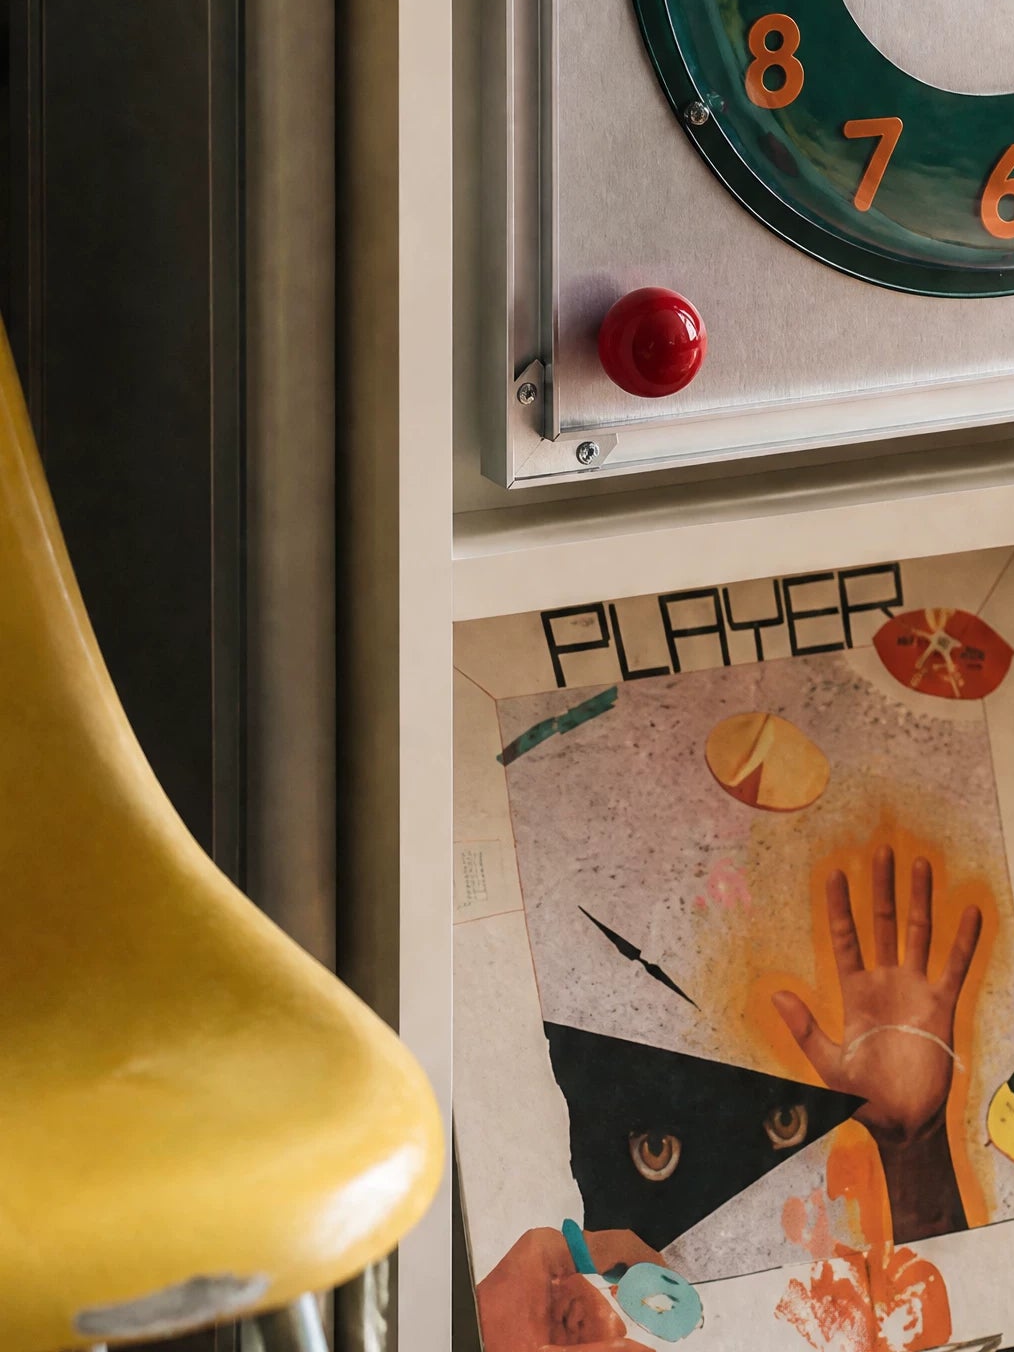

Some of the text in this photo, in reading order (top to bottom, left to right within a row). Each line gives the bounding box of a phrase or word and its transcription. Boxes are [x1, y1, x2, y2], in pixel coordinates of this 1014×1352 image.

[746, 13, 804, 109] 8
[844, 117, 903, 212] 7
[540, 562, 904, 688] PLAYER
